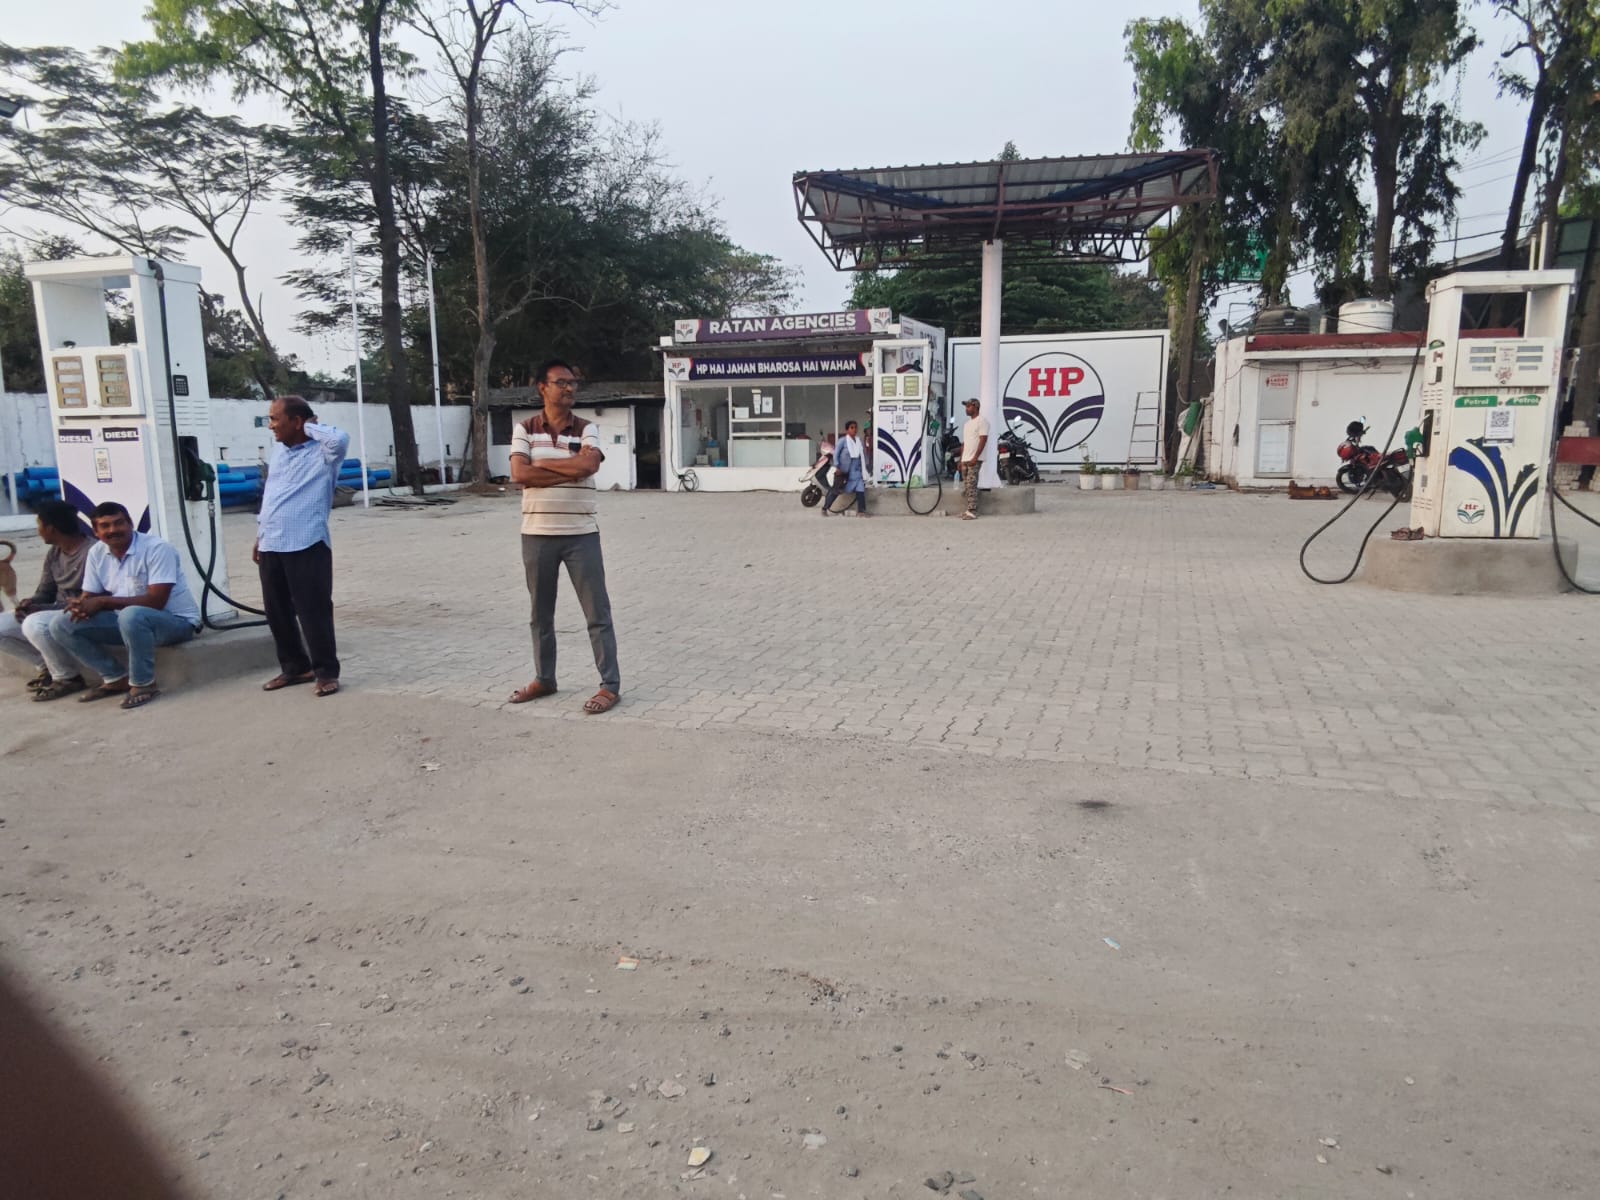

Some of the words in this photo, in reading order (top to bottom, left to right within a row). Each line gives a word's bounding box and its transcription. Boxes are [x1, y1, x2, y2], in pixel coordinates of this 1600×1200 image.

[709, 319, 766, 334] RATAN
[770, 313, 856, 330] AGENCIES
[696, 363, 708, 374] HP
[710, 363, 725, 374] HAI
[727, 362, 756, 373] JAHAN
[758, 361, 801, 373] BHAROSA
[803, 360, 819, 371] HAI
[821, 360, 856, 371] WAHAN
[1028, 367, 1085, 397] HP
[1464, 396, 1489, 405] Petrol
[1513, 396, 1539, 404] Petrol
[59, 435, 92, 443] DIESEL
[104, 431, 139, 439] DIESEL
